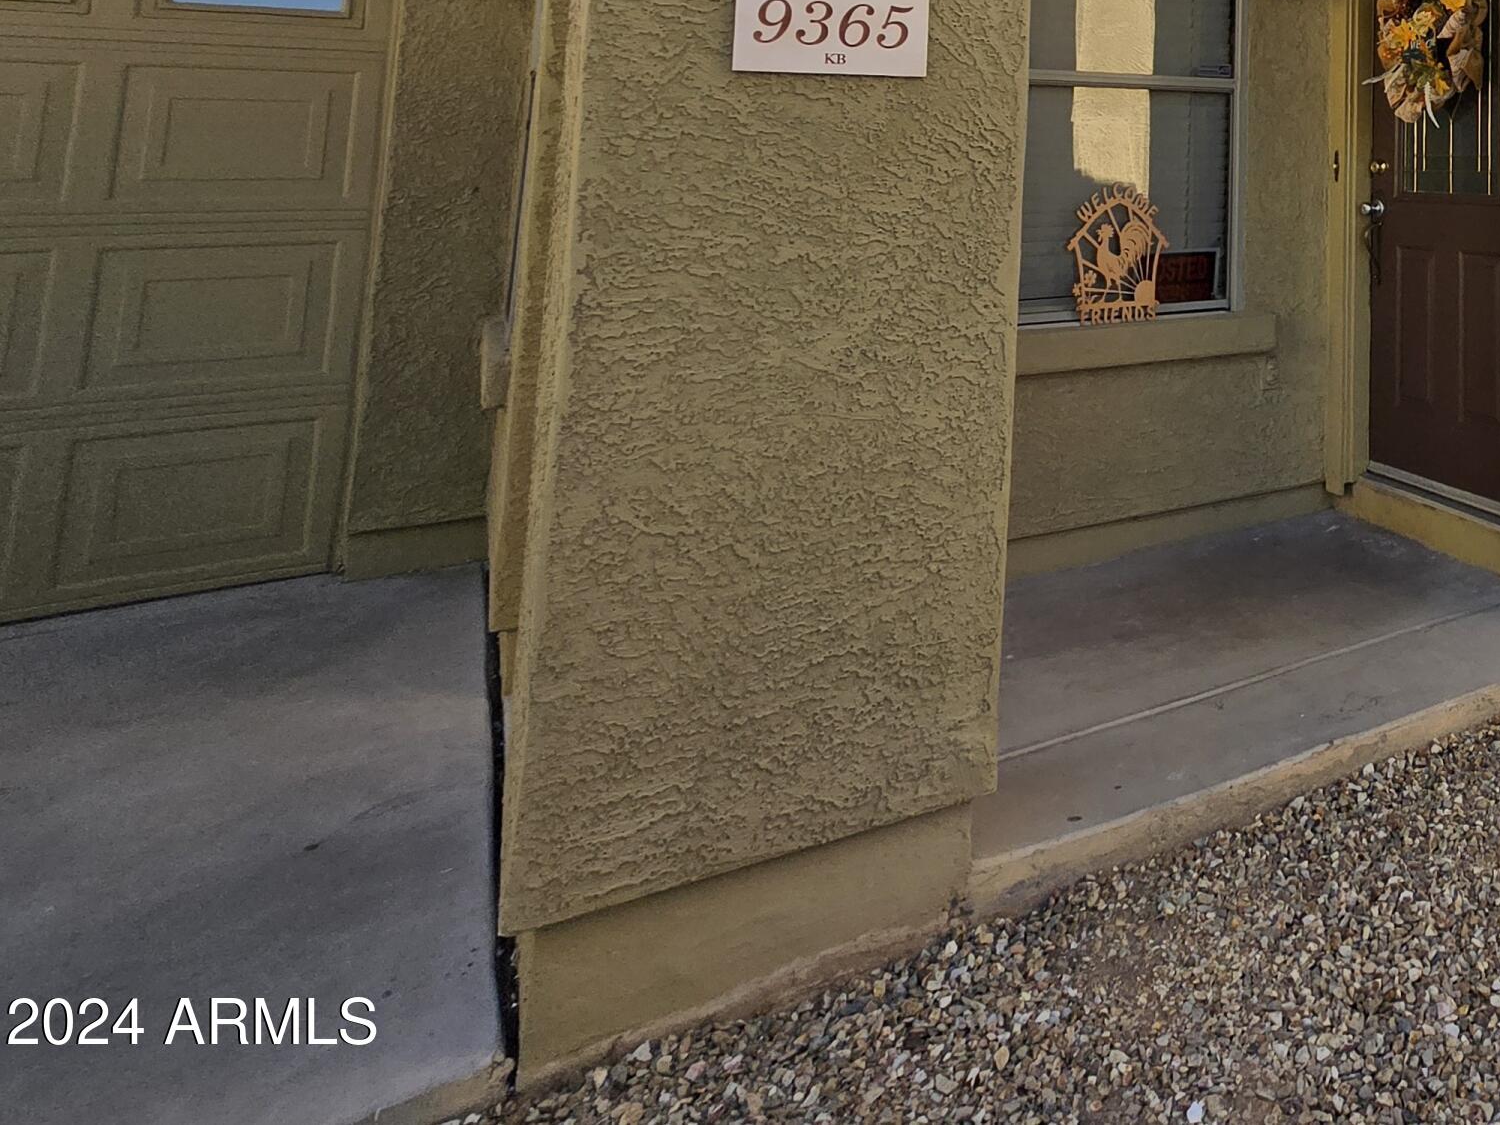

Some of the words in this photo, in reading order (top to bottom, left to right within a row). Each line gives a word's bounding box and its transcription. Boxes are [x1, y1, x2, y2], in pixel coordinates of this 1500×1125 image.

[824, 53, 847, 65] KB
[1076, 181, 1160, 223] WELCOME
[1079, 305, 1157, 327] FRIENDS
